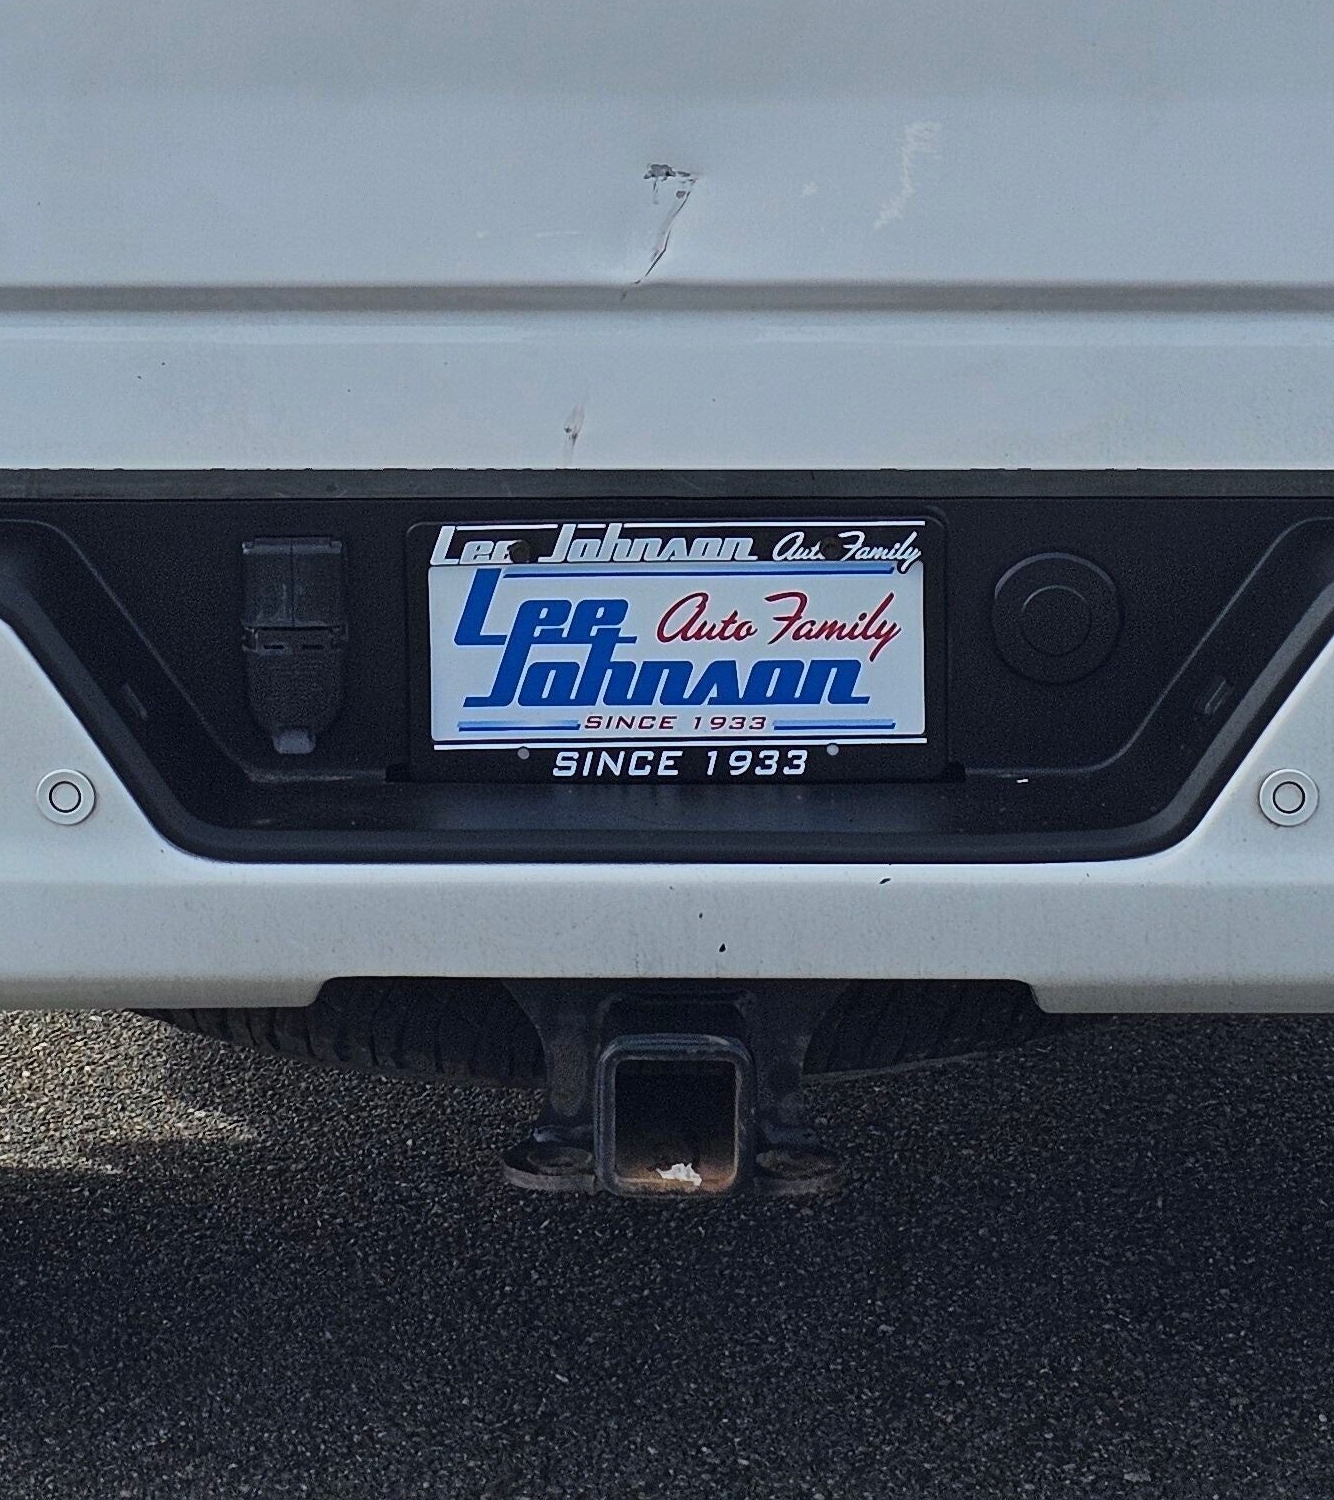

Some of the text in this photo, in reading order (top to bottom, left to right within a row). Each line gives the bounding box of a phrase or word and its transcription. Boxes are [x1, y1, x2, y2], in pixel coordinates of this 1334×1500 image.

[537, 522, 759, 564] Johnson
[771, 531, 831, 562] Aut
[837, 530, 922, 573] Family
[453, 568, 903, 663] Lee Auto Family
[462, 630, 871, 708] Johnson
[584, 715, 768, 730] SINCE 1933
[552, 749, 809, 777] SINCE 1933
